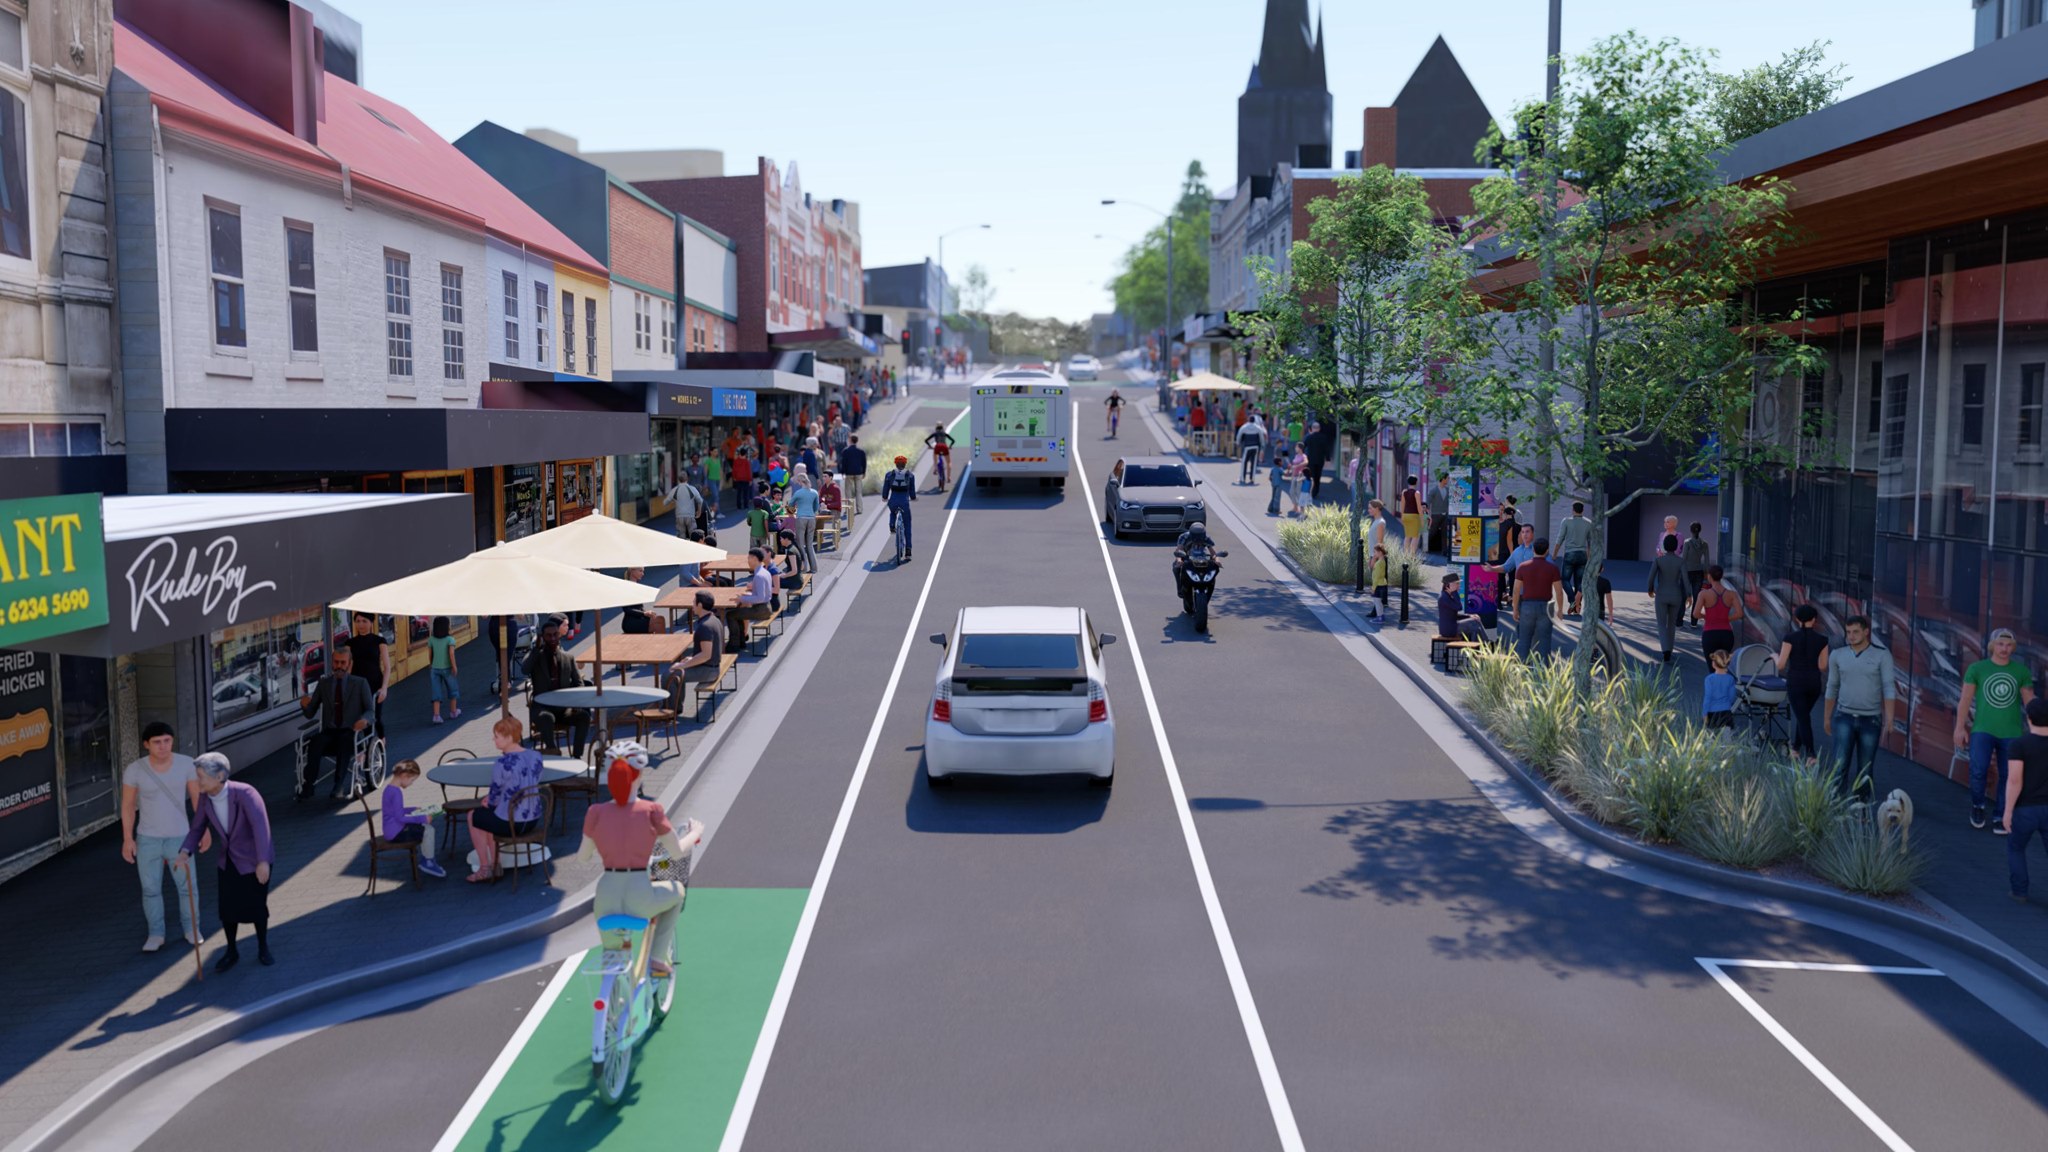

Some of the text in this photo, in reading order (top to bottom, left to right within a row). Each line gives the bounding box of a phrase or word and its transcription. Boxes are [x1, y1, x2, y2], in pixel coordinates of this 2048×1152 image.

[722, 394, 731, 410] THE
[8, 595, 49, 624] 6234
[52, 587, 89, 616] 5690
[0, 651, 35, 673] FRIED
[18, 720, 47, 742] AWAY
[0, 781, 51, 810] RDER ONLINE
